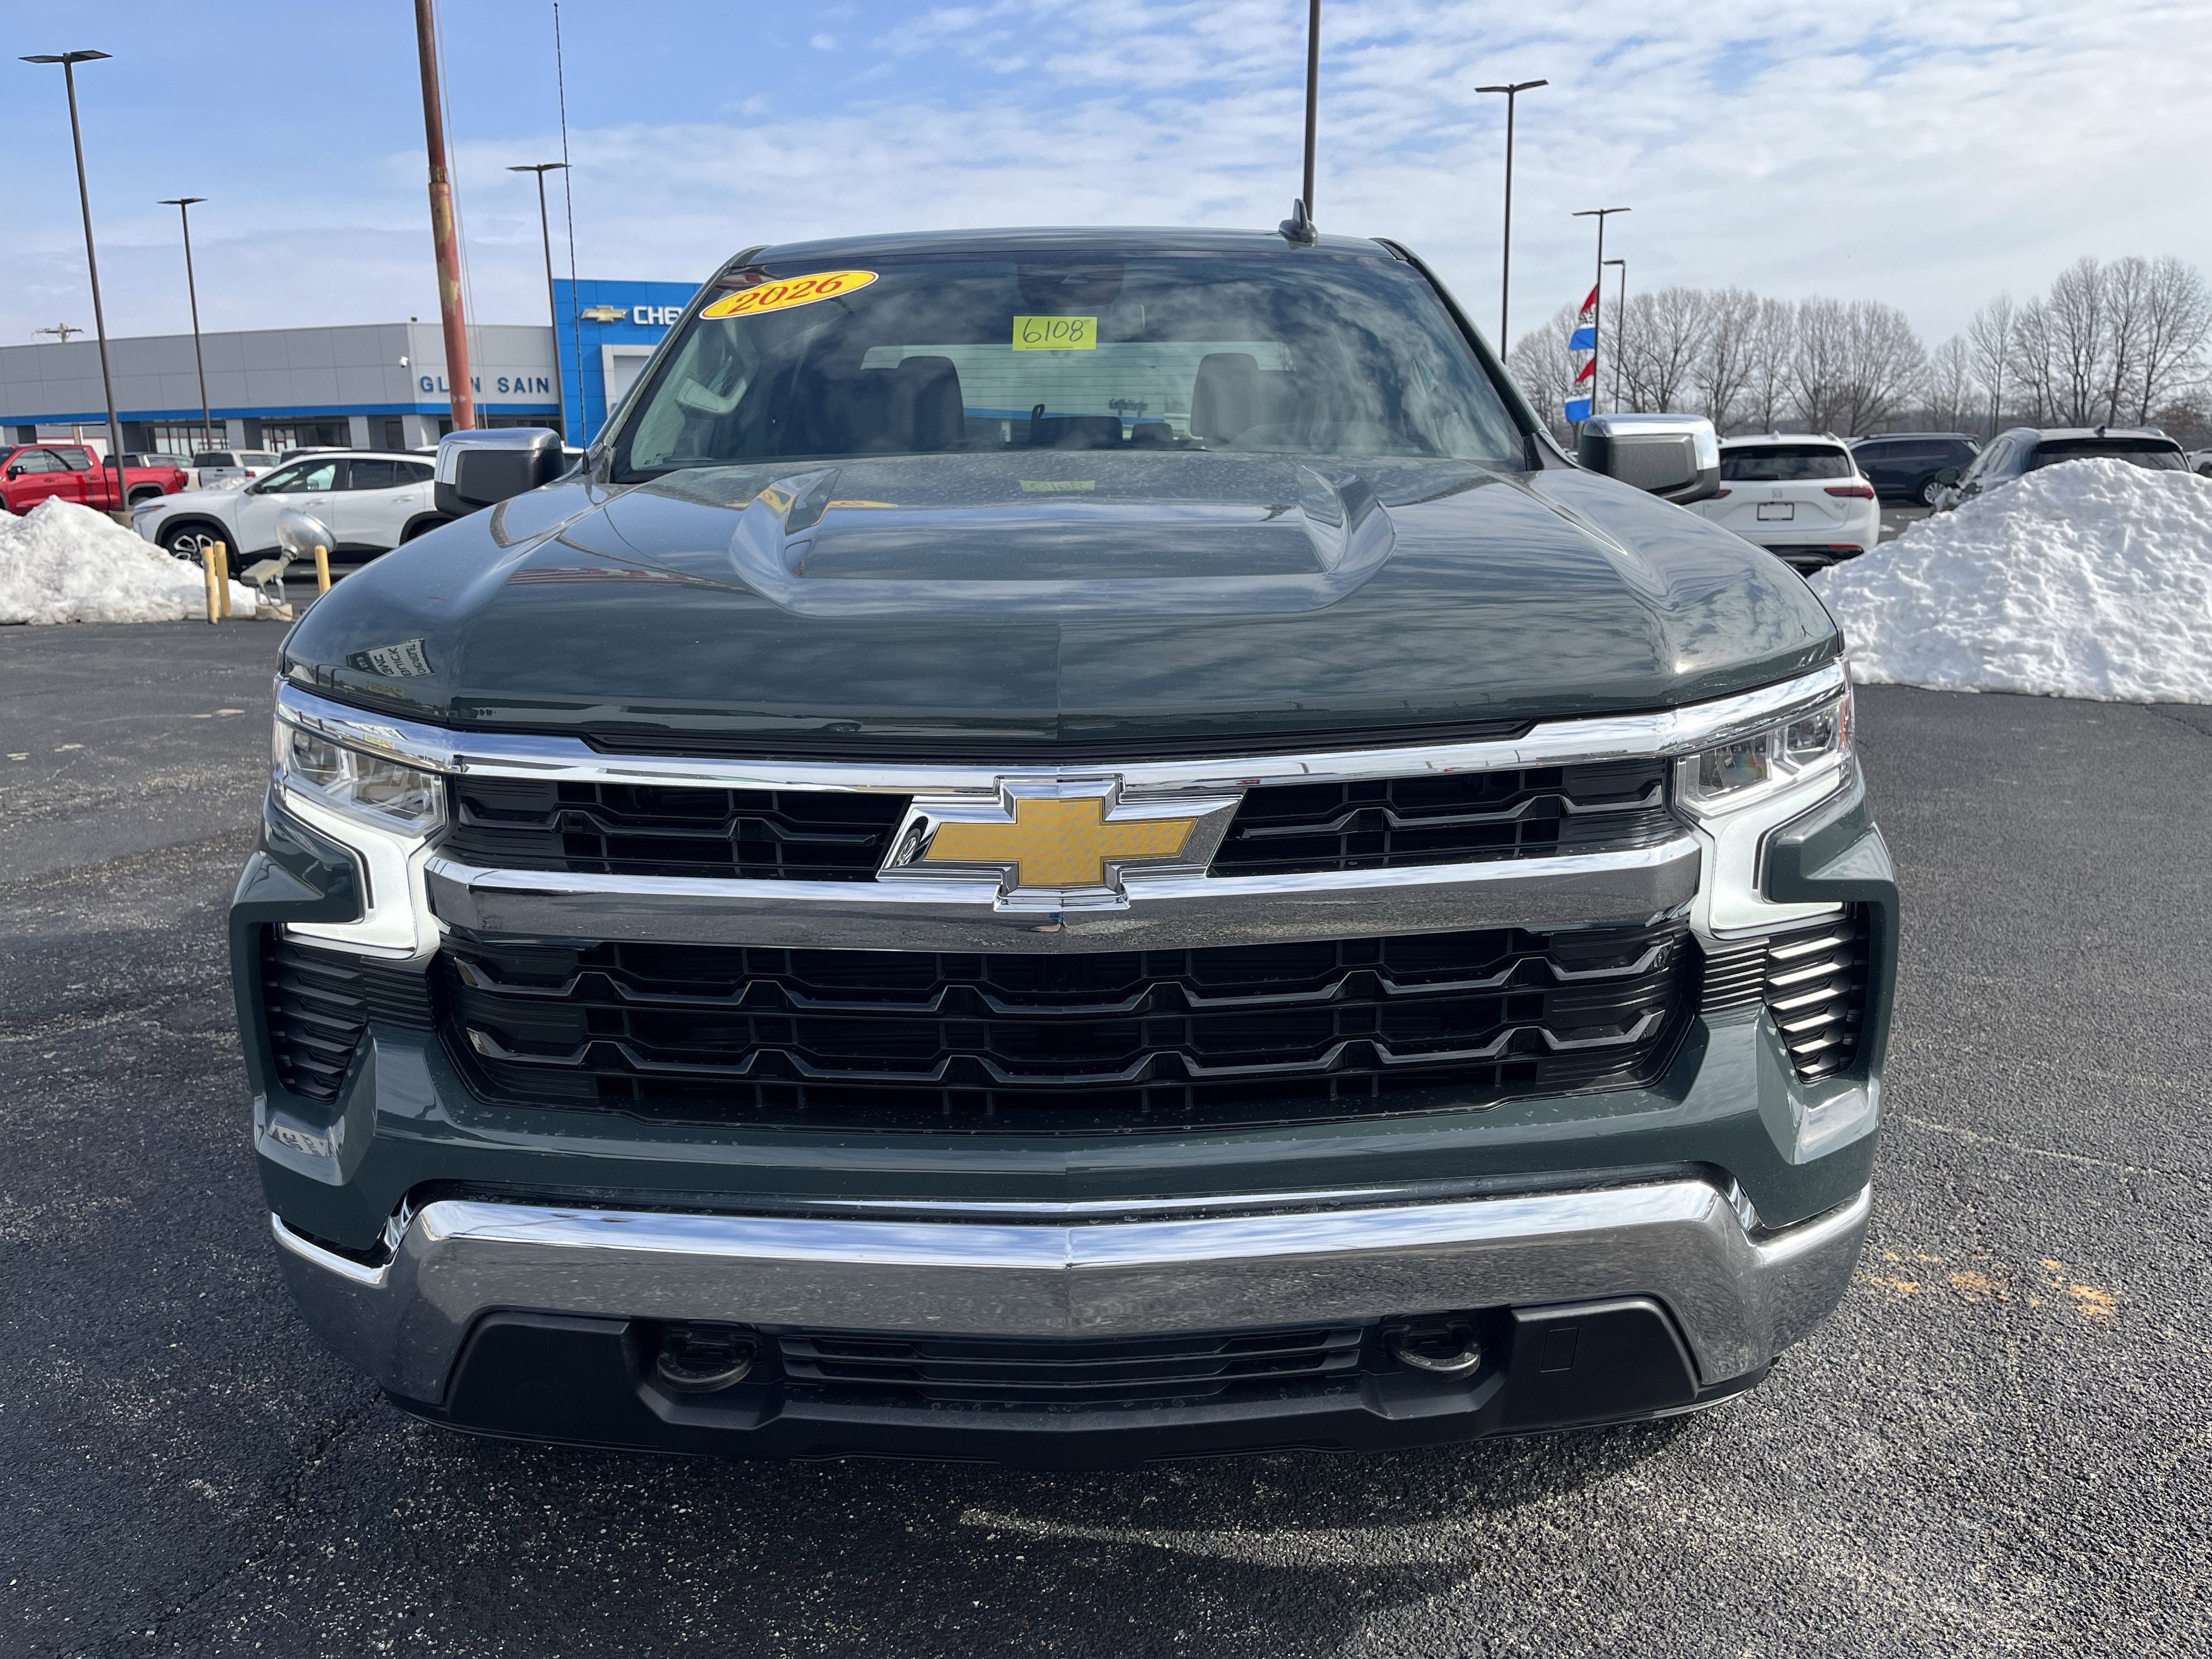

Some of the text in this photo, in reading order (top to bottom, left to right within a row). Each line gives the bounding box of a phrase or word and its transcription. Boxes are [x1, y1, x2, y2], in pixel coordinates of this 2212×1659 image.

[727, 274, 850, 314] 2026
[633, 306, 684, 325] CHE
[1023, 318, 1084, 343] 6108
[420, 376, 549, 393] GLN SAIN
